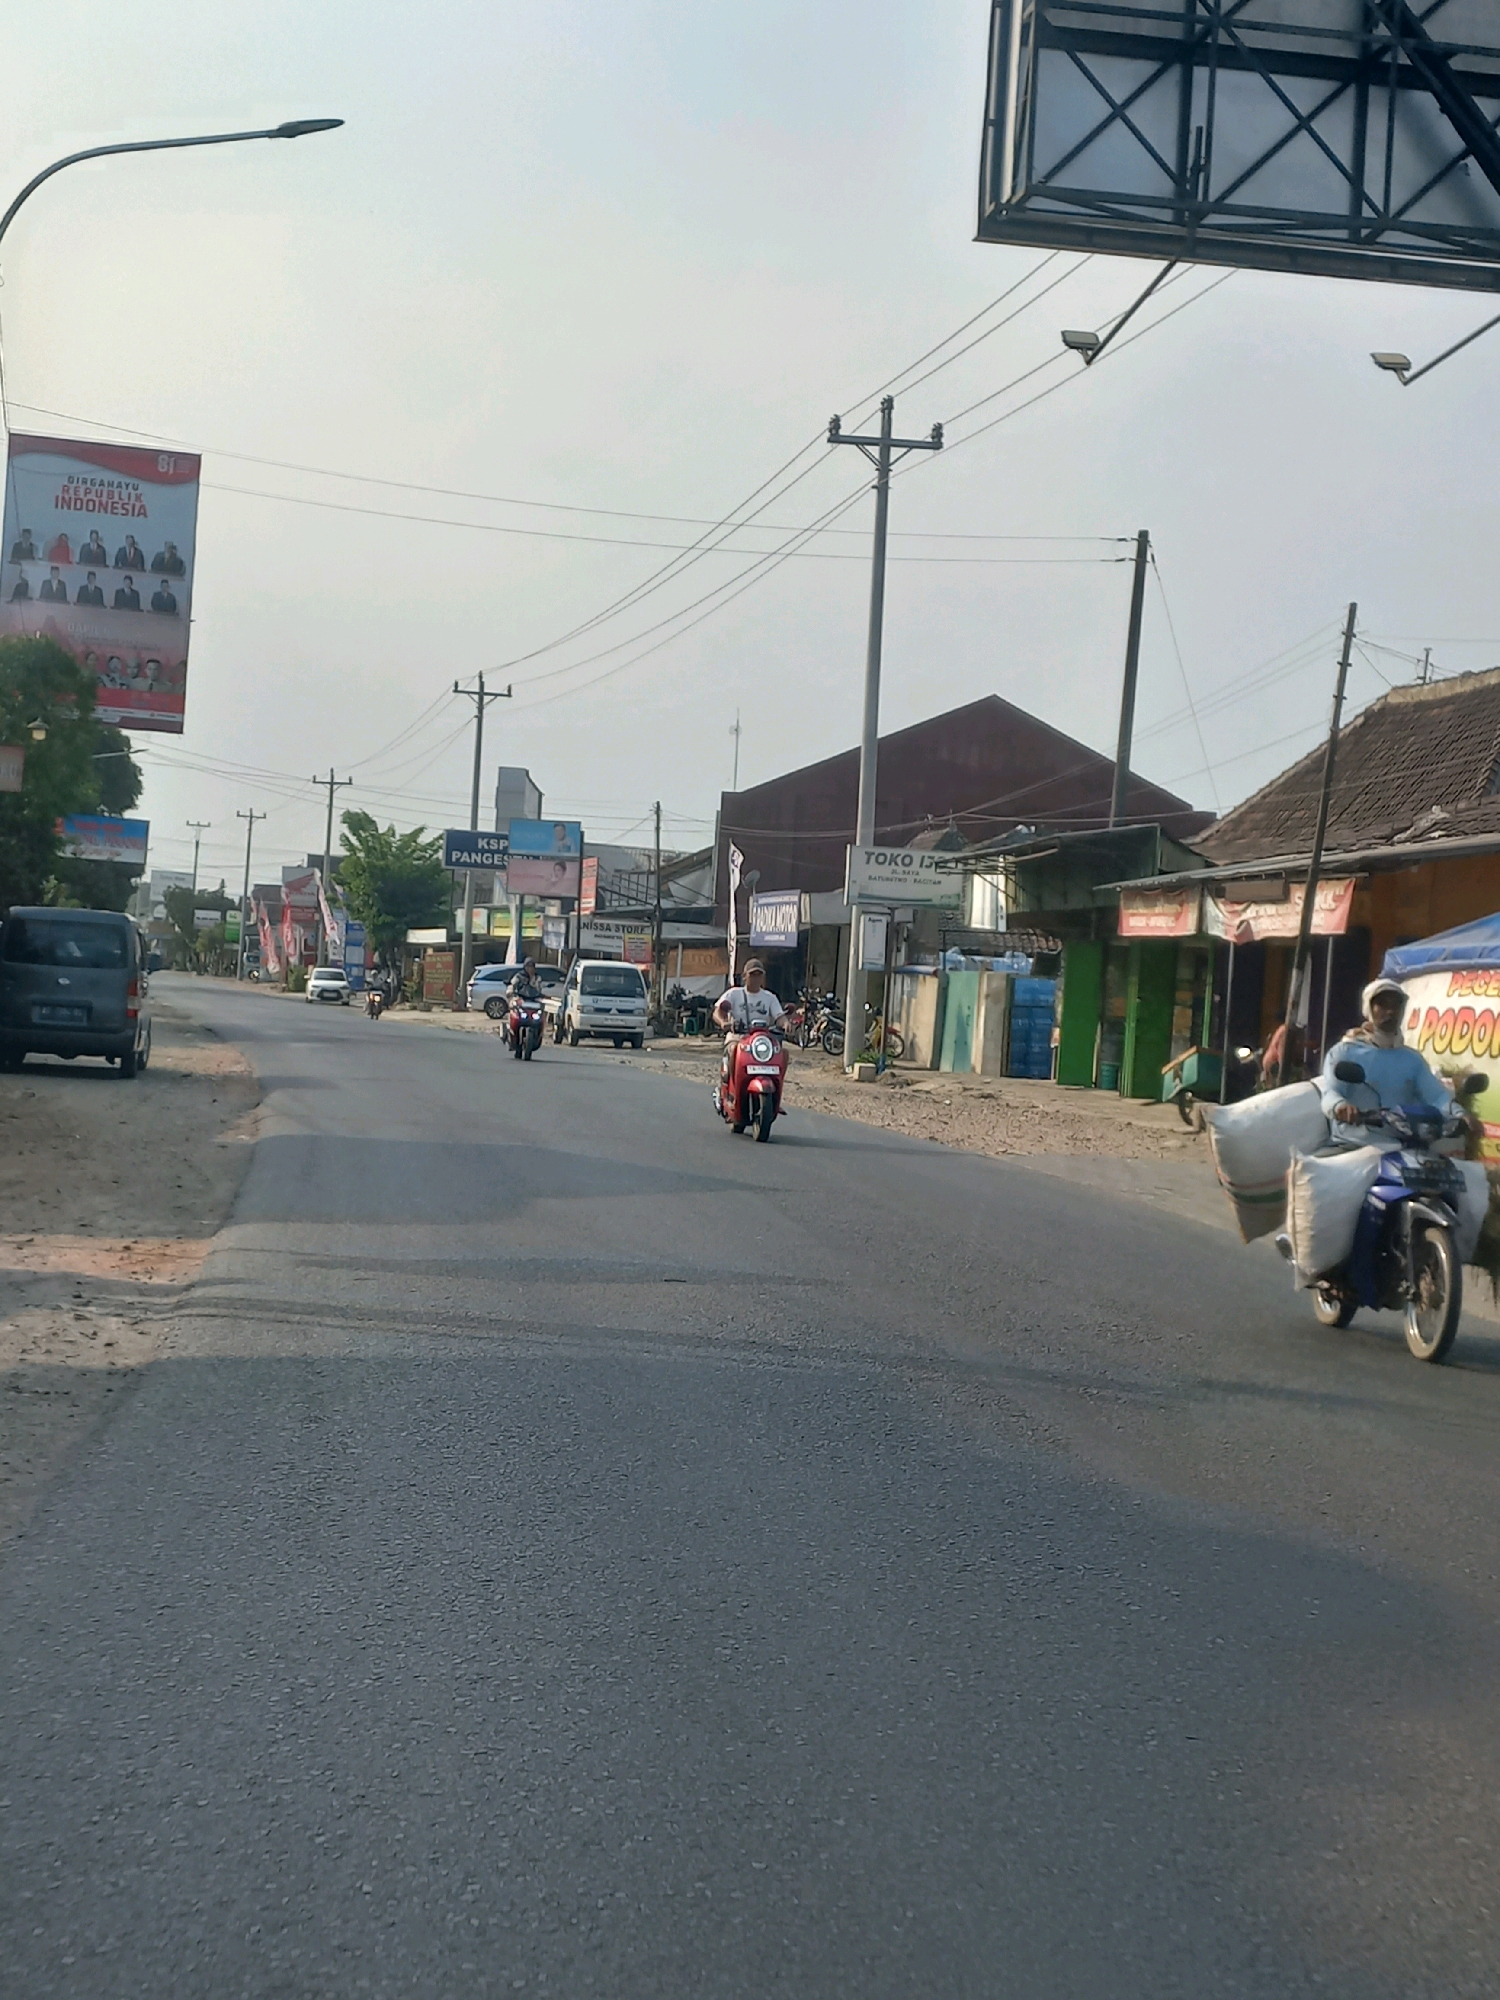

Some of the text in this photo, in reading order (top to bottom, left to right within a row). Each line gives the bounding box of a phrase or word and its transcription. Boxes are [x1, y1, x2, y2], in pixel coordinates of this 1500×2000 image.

[67, 475, 140, 491] DIRGAHAYU
[61, 484, 144, 503] REPUBLIK
[54, 494, 148, 518] INDONESIA
[477, 837, 509, 850] KSP
[864, 851, 914, 867] TOKO
[1447, 969, 1500, 997] PECE
